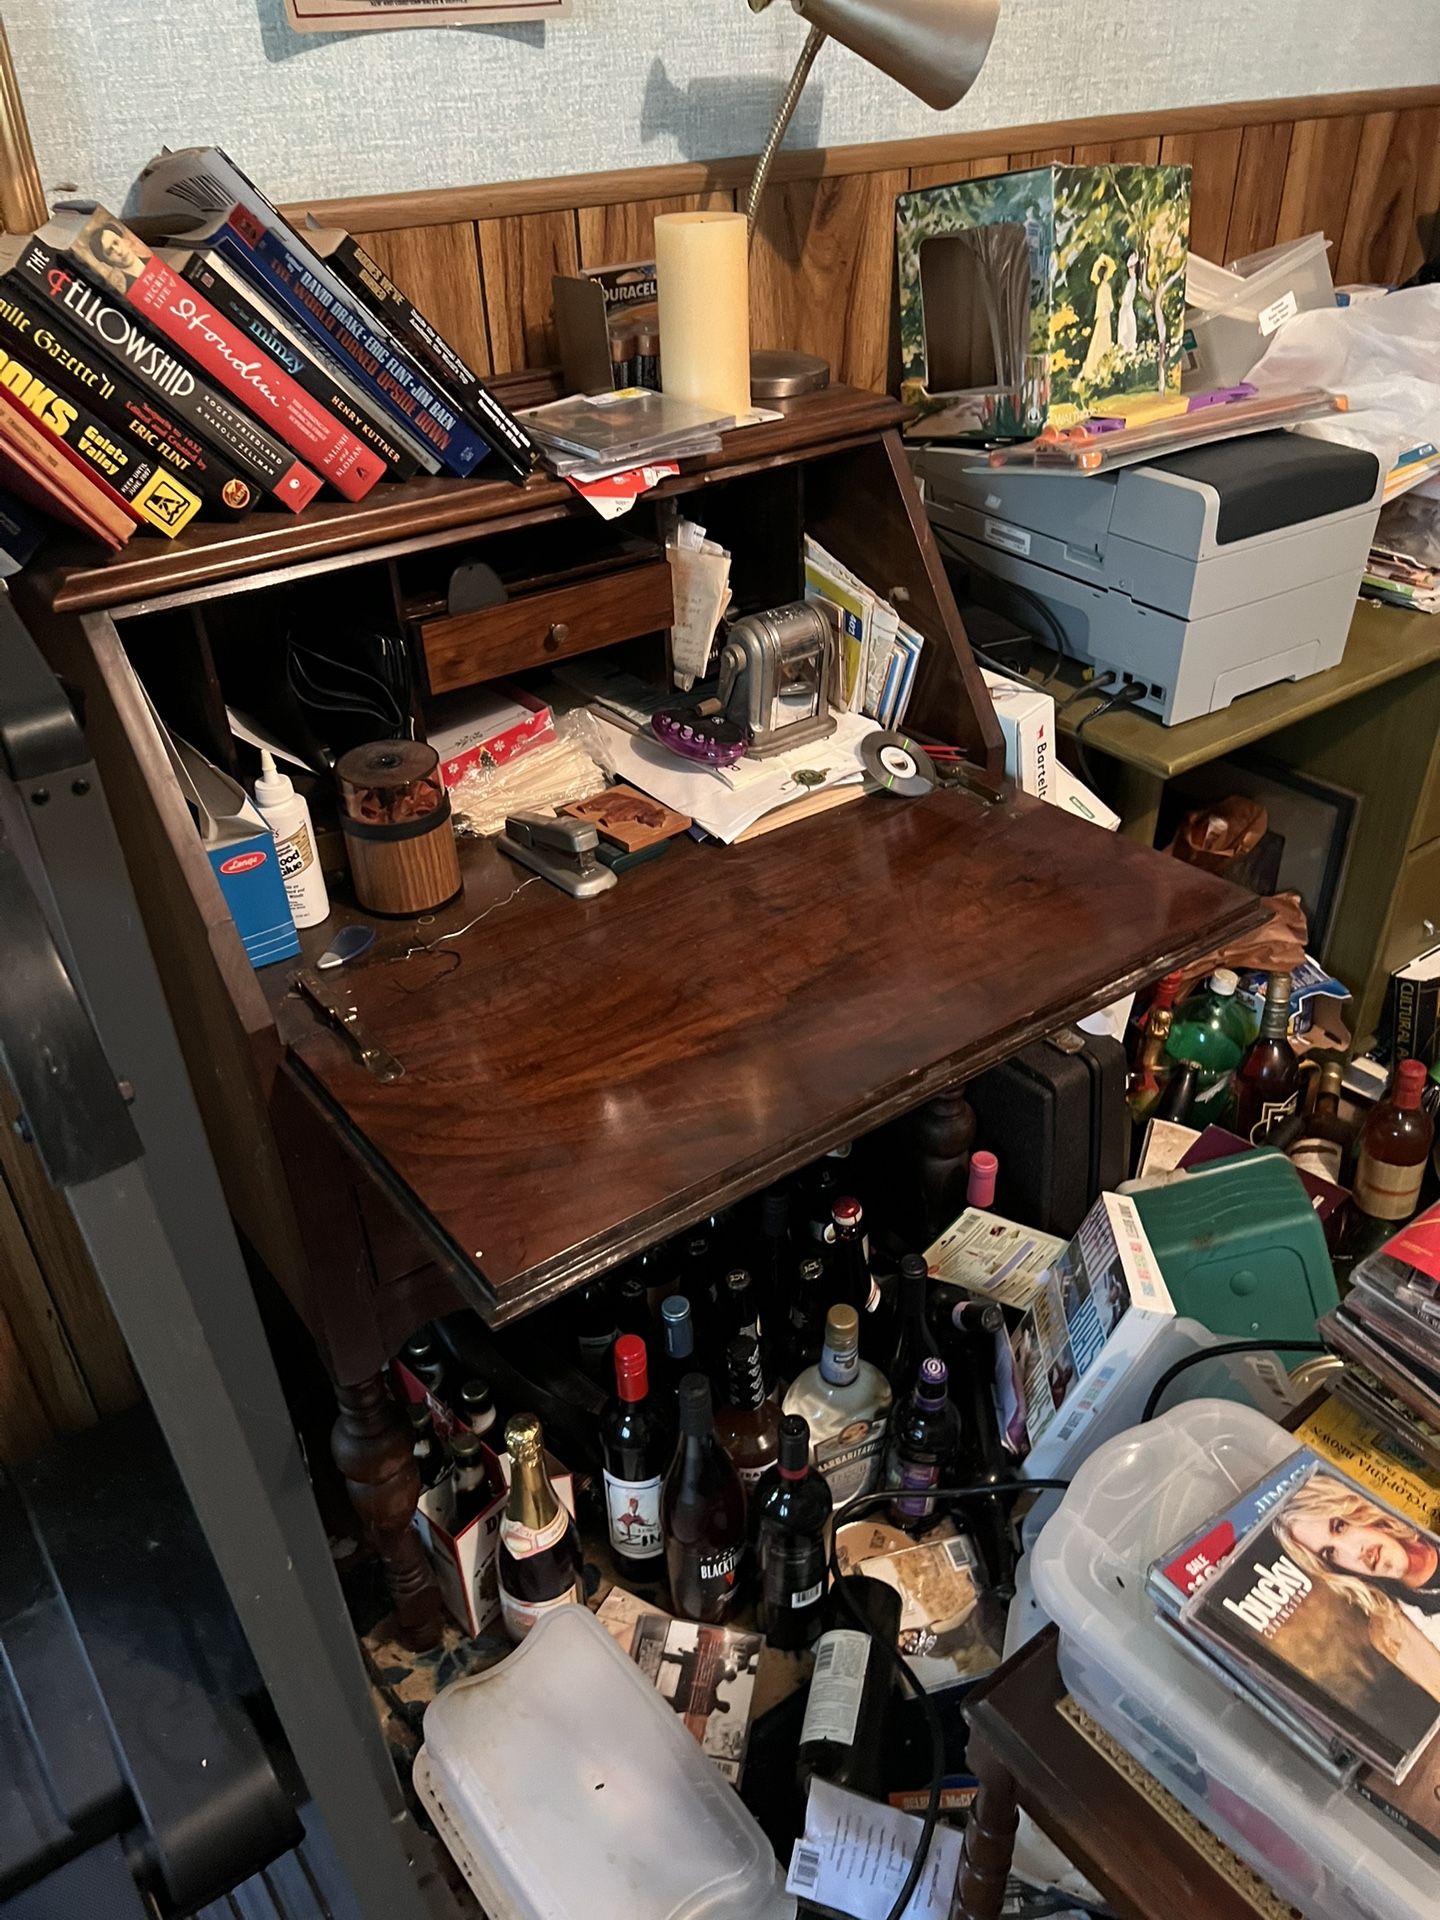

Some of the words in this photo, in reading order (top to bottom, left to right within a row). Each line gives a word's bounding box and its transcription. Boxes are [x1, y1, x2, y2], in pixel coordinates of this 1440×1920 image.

[26, 247, 50, 274] THE
[144, 270, 169, 304] SECRET
[154, 289, 171, 309] LIFE
[33, 328, 100, 388] Gazette
[47, 268, 196, 397] FELLOWSHIP
[169, 298, 286, 407] Houdini
[249, 319, 304, 375] mimzy
[270, 257, 292, 283] THE
[293, 281, 338, 331] WORLD
[335, 326, 381, 376] TURNED
[376, 373, 417, 417] UPSIDE
[414, 411, 453, 451] DOWN
[300, 271, 334, 308] DAVID
[330, 301, 365, 340] DRAKE
[364, 335, 389, 363] ERIC
[386, 357, 413, 388] FLINT
[410, 386, 433, 409] JIM
[429, 403, 457, 431] BAEN
[84, 425, 129, 466] Goleta
[128, 419, 159, 447] ERIC
[157, 441, 191, 470] FLINT
[196, 405, 203, 414] &
[203, 411, 237, 443] HAROLD
[237, 442, 275, 476] ZELLMAN
[204, 395, 233, 422] ROGER
[236, 421, 283, 465] FRIEDLAND
[331, 395, 363, 426] HENRY
[362, 423, 401, 463] KUTTNER
[78, 436, 120, 476] Valley
[121, 475, 135, 493] KEEP
[133, 462, 148, 479] UNTIL
[128, 479, 142, 496] JUNE
[280, 850, 300, 866] ood
[1397, 981, 1414, 1043] CULTURAL
[1069, 1295, 1106, 1376] BOATS
[1312, 1426, 1355, 1460] BROWN
[1185, 1553, 1210, 1576] SALE
[1222, 1555, 1313, 1633] bucky
[1263, 1588, 1307, 1639] COVINGTON
